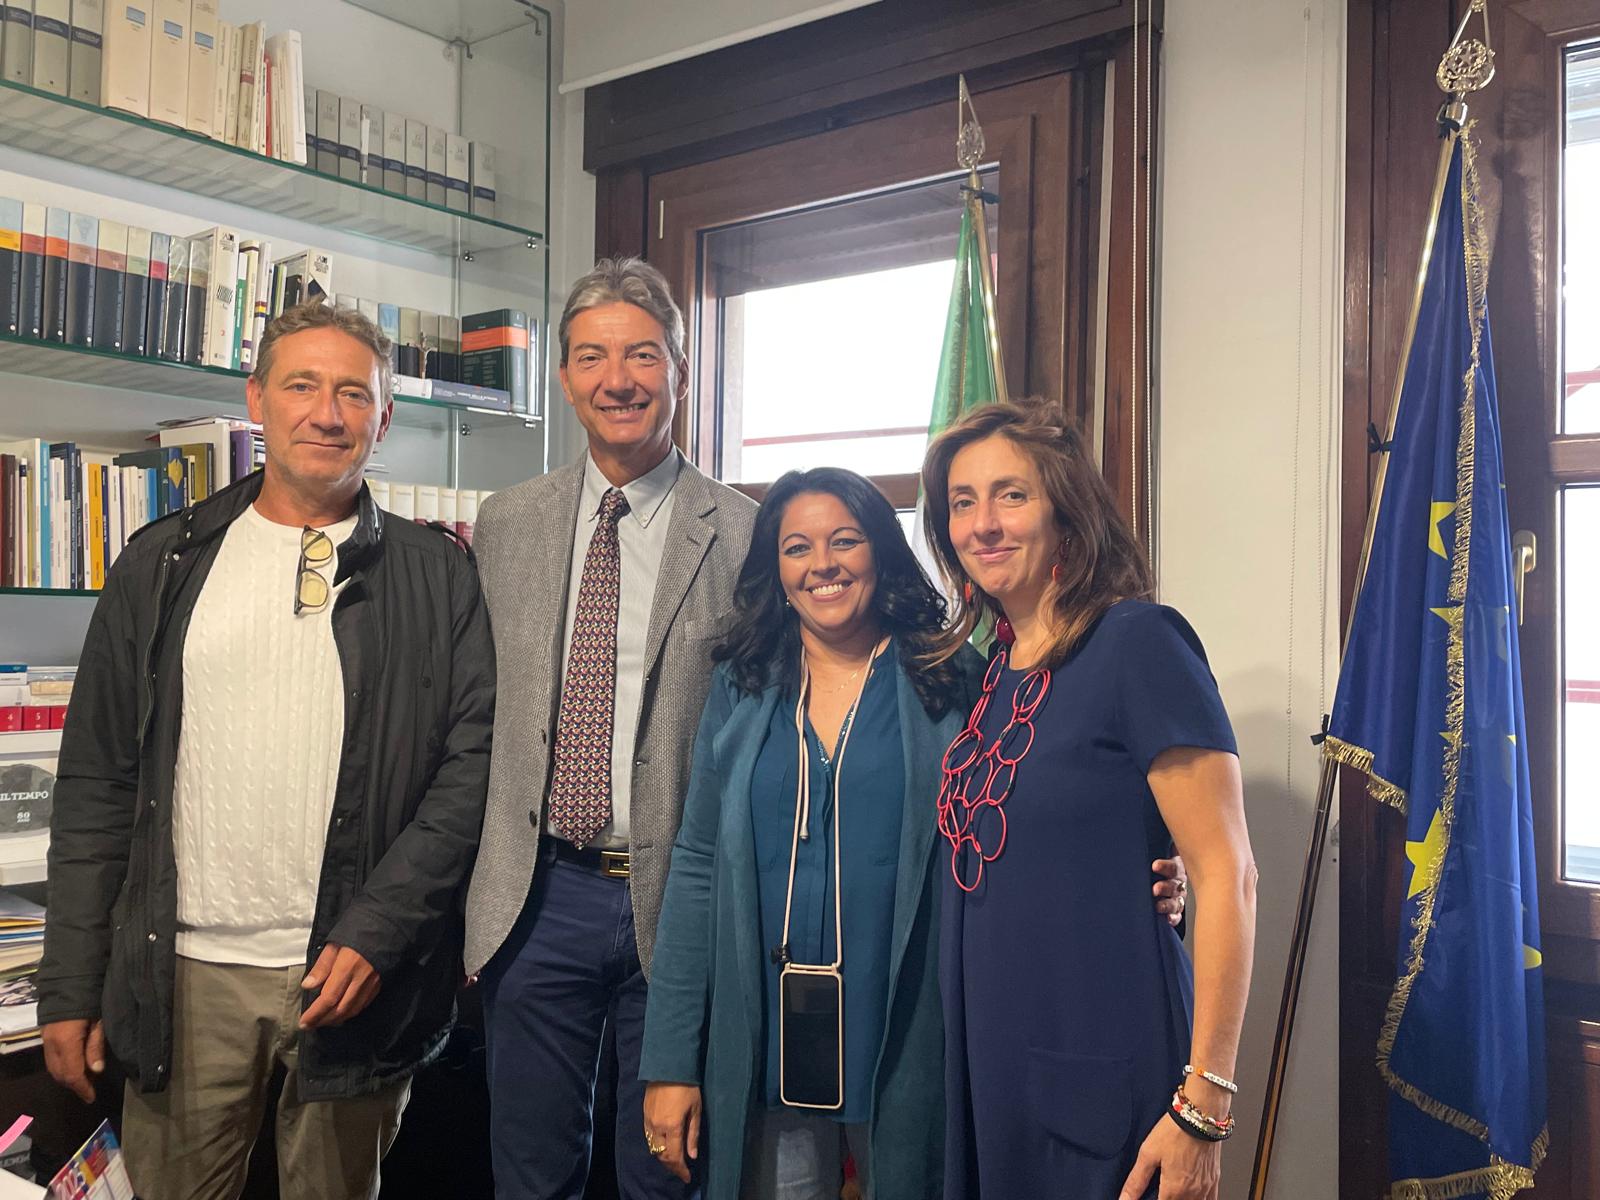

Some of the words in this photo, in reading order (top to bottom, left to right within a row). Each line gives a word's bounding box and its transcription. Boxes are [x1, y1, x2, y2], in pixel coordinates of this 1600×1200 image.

[8, 713, 13, 721] 4
[35, 712, 41, 721] 5
[0, 792, 11, 801] IL
[11, 790, 49, 801] TEMPO
